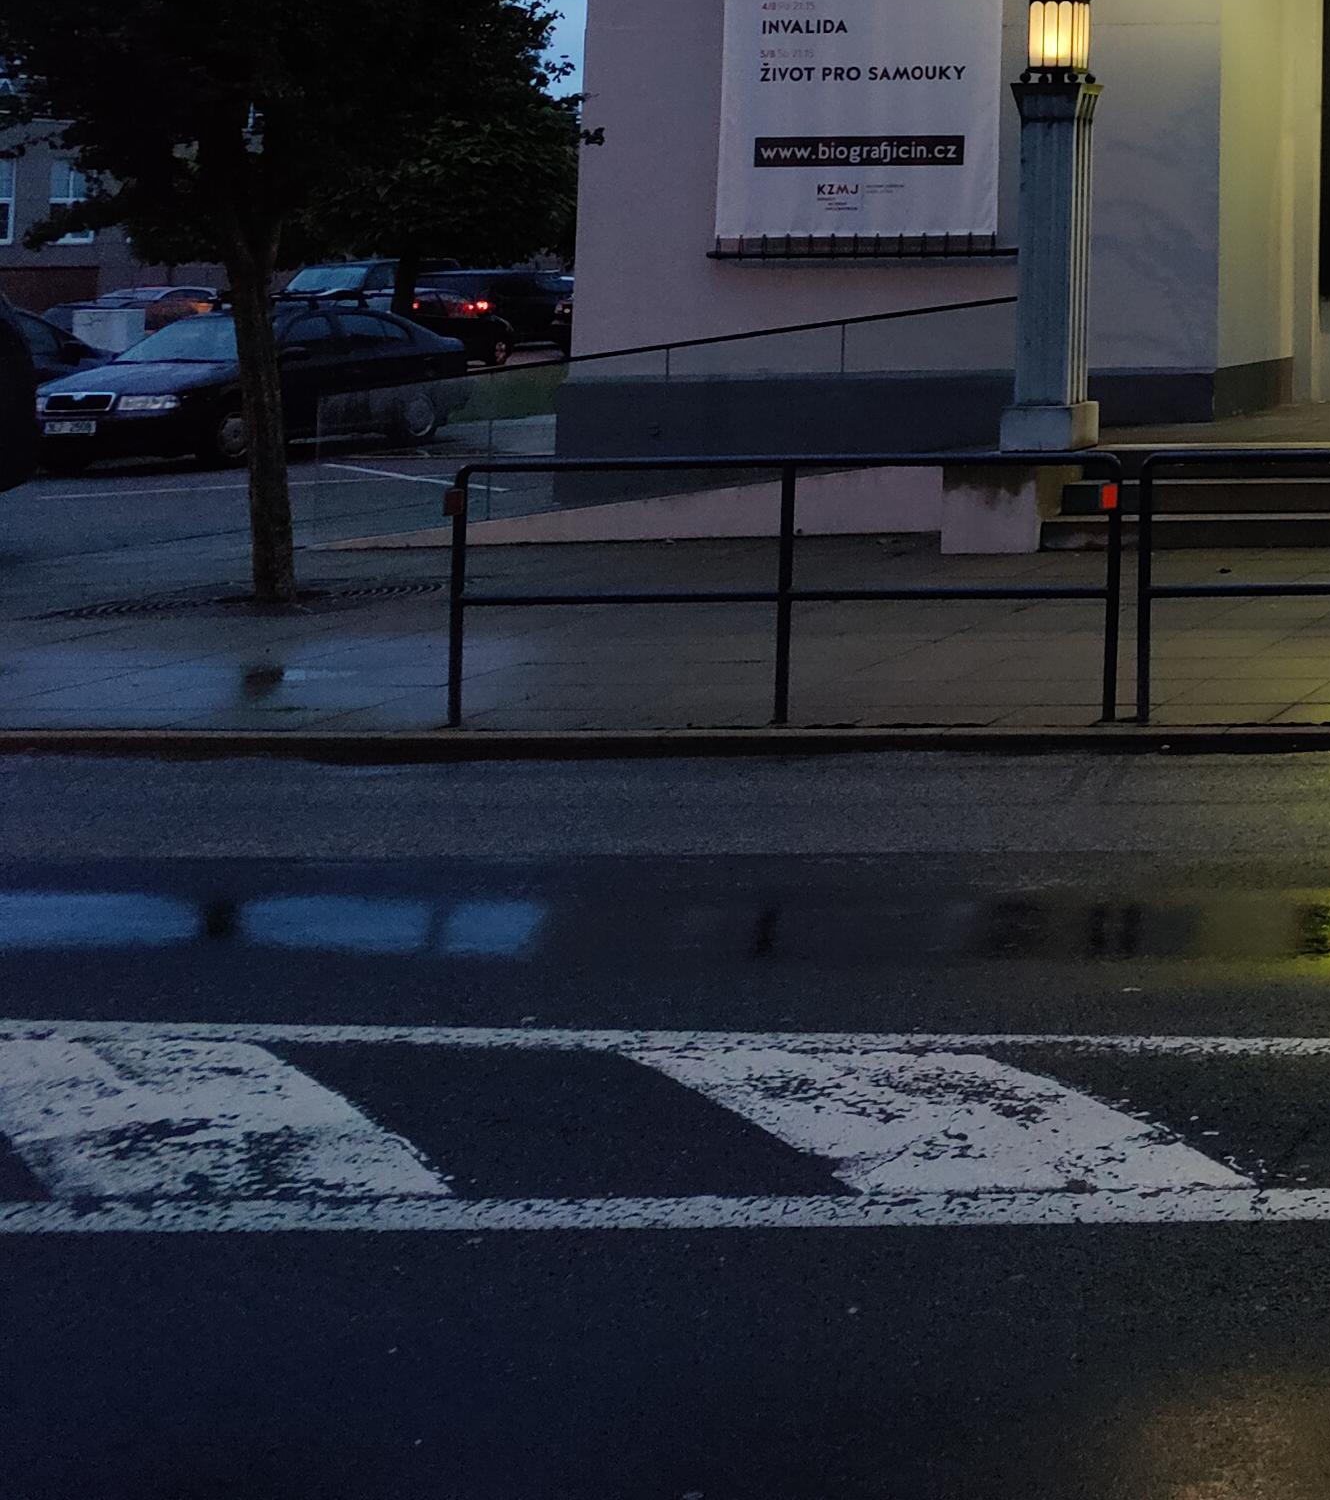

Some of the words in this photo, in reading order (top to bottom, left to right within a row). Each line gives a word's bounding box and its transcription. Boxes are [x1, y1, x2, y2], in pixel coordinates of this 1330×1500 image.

[762, 19, 848, 35] INVALIDA
[760, 63, 815, 82] ŽIVOT
[822, 67, 861, 82] PRO
[868, 65, 966, 81] SAMOUKY
[760, 141, 957, 164] www.biografjicin.cz
[817, 184, 859, 196] KZMJ
